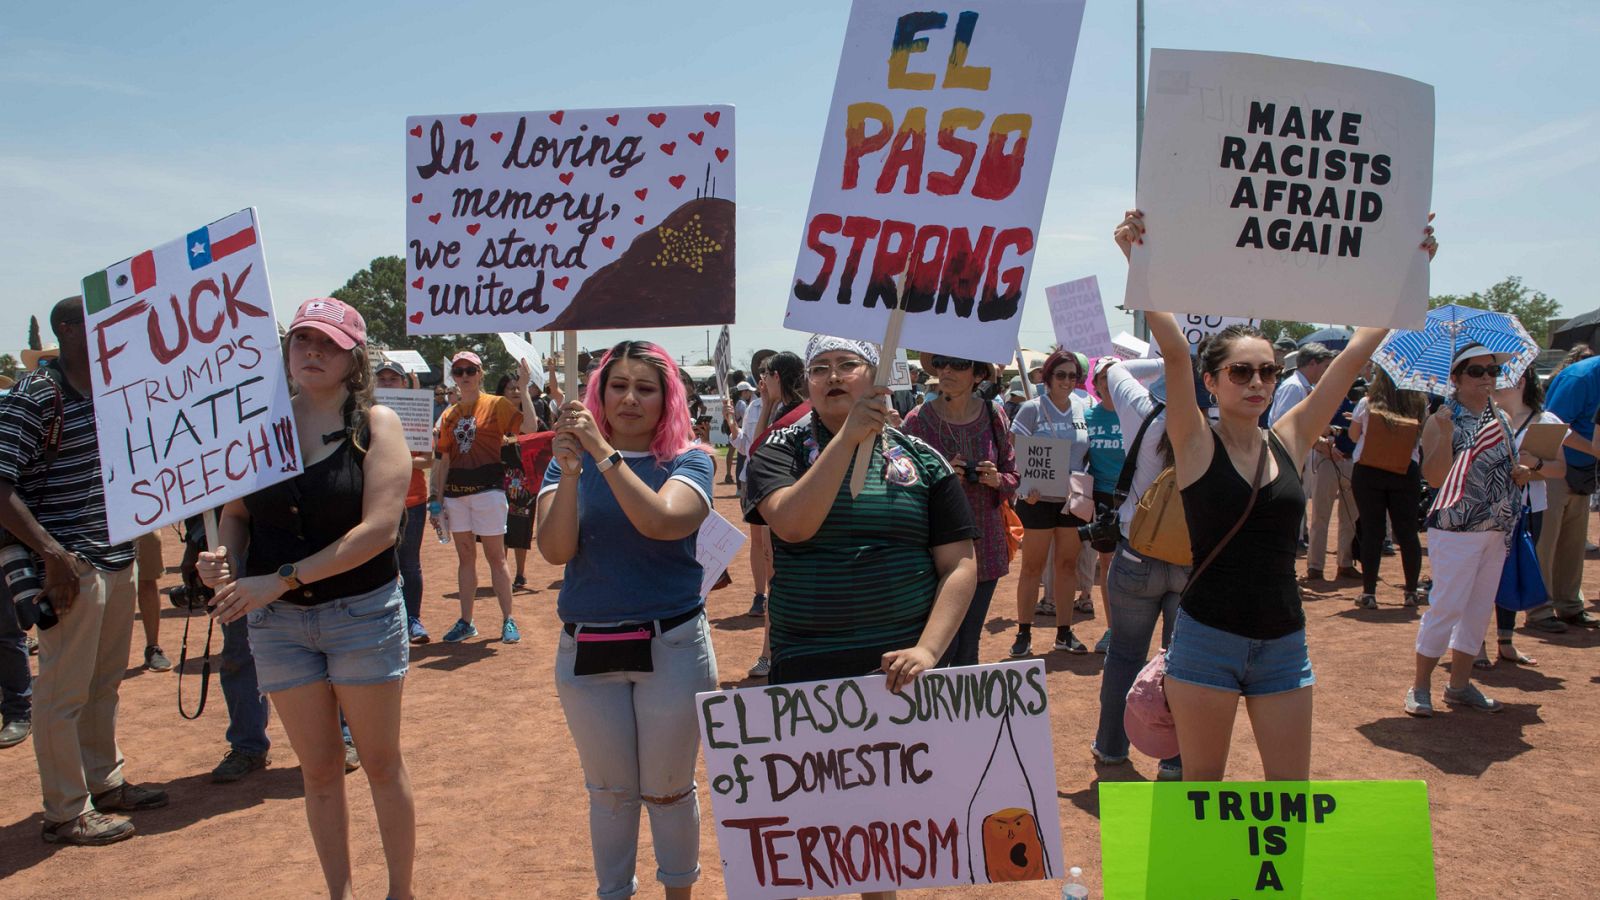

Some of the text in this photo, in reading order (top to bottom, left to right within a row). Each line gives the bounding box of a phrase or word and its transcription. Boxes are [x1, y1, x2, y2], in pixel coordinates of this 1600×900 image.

[887, 10, 991, 91] EL
[1247, 101, 1362, 146] MAKE
[415, 116, 647, 180] In loving
[841, 101, 1033, 201] PASO
[1219, 136, 1392, 185] RACISTS
[451, 186, 621, 235] memory,
[1230, 176, 1383, 223] AFRAID
[409, 228, 588, 271] we stand
[1235, 216, 1363, 258] AGAIN
[793, 212, 1034, 323] STRONG
[427, 269, 550, 317] united
[91, 262, 270, 387] FUCK
[99, 334, 264, 424] TRUMP'S
[50, 415, 62, 445] Canon
[125, 375, 268, 475] HATE
[1088, 425, 1106, 436] EL
[1024, 469, 1056, 480] MORE
[1028, 446, 1053, 458] NOT
[1028, 458, 1052, 469] ONE
[702, 666, 1048, 750] EL PASO, SURVIVORS
[712, 741, 933, 804] of DOMESTIC
[1187, 790, 1337, 824] TRUMP
[721, 816, 959, 890] TERRORISM
[1247, 825, 1288, 856] IS
[1255, 860, 1284, 891] A
